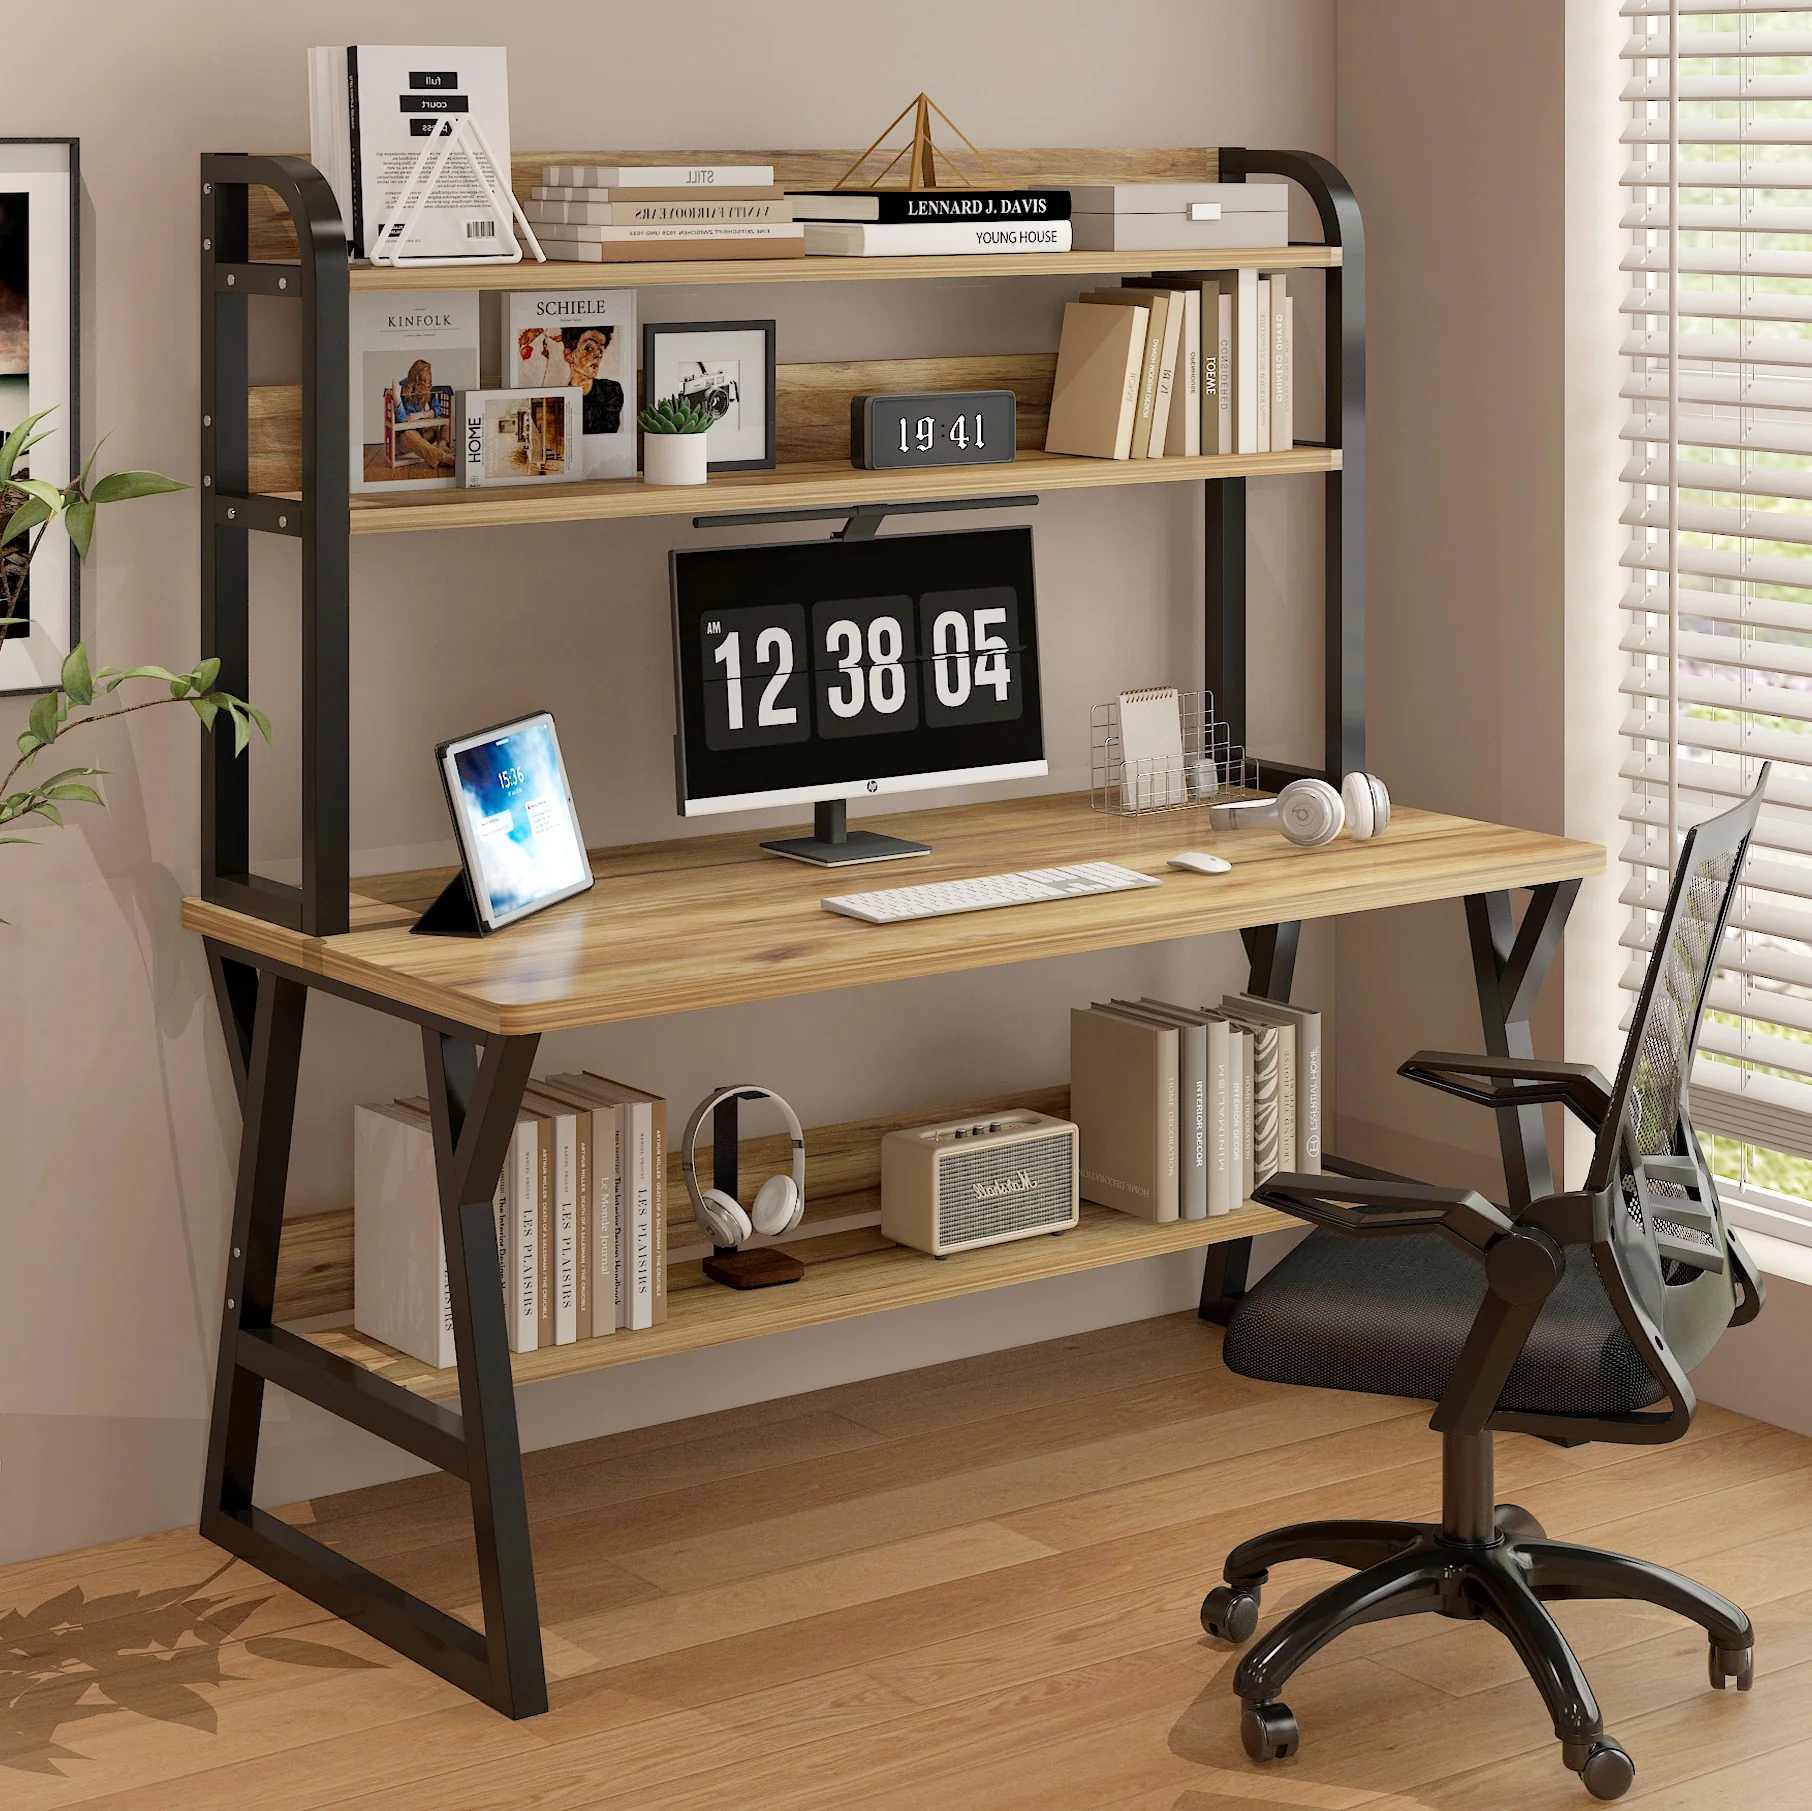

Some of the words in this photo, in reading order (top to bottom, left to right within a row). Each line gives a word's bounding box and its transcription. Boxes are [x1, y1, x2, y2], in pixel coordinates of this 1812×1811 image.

[908, 200, 982, 216] LENNARD
[985, 200, 997, 214] J.
[1000, 198, 1047, 214] DAVIS
[976, 232, 1016, 244] YOUNG
[1019, 230, 1057, 243] HOUSE
[388, 314, 452, 327] KINFOLK
[536, 300, 605, 316] SCHIELE
[468, 417, 482, 463] HOME
[899, 414, 985, 453] 19:41
[706, 621, 721, 635] AM
[714, 626, 797, 730] 12
[826, 616, 906, 718] 38
[498, 766, 524, 790] 15:36
[601, 1177, 609, 1190] Le
[1127, 1184, 1149, 1198] HOME
[601, 1194, 609, 1232] Monde
[638, 1189, 647, 1216] LES
[523, 1209, 532, 1237] LES
[562, 1203, 572, 1230] LES
[600, 1235, 610, 1275] Journal
[638, 1224, 647, 1294] PLAISIRS
[523, 1244, 532, 1316] PLAISIRS
[562, 1238, 572, 1309] PLAISIRS
